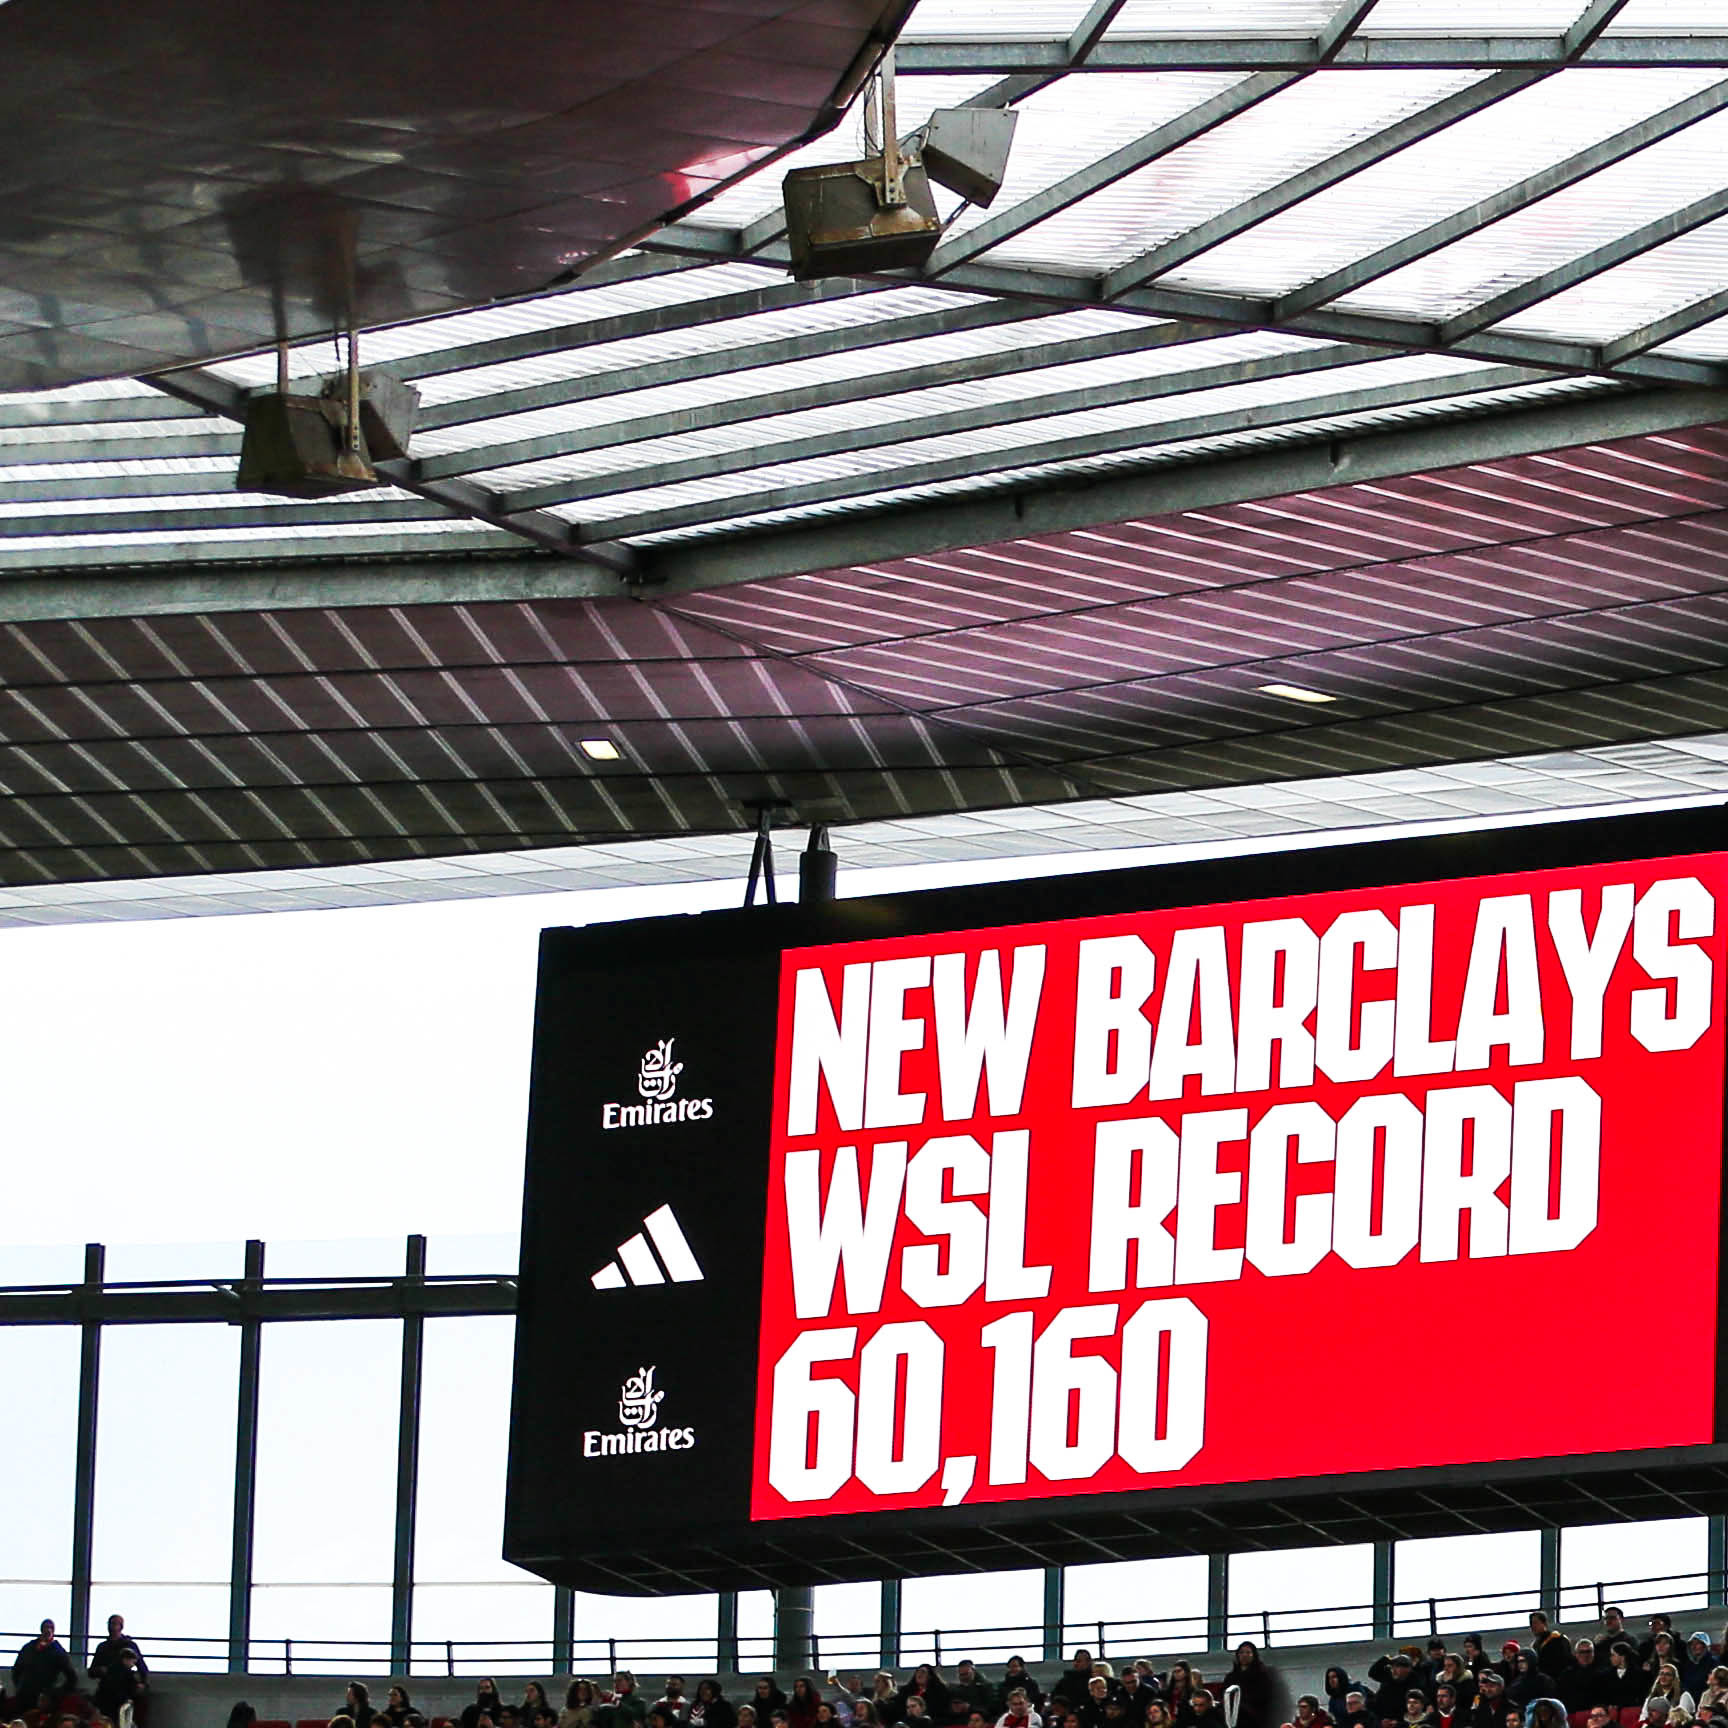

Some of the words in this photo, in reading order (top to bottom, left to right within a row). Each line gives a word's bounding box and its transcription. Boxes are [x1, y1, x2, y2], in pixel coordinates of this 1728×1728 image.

[786, 942, 1046, 1136] NEW
[1071, 876, 1716, 1110] BARCLAYS
[602, 1098, 714, 1129] Emirates
[785, 1132, 1054, 1318] WSL
[1089, 1075, 1601, 1294] RECORD
[583, 1426, 695, 1457] Emirates
[769, 1297, 1208, 1508] 60,160
